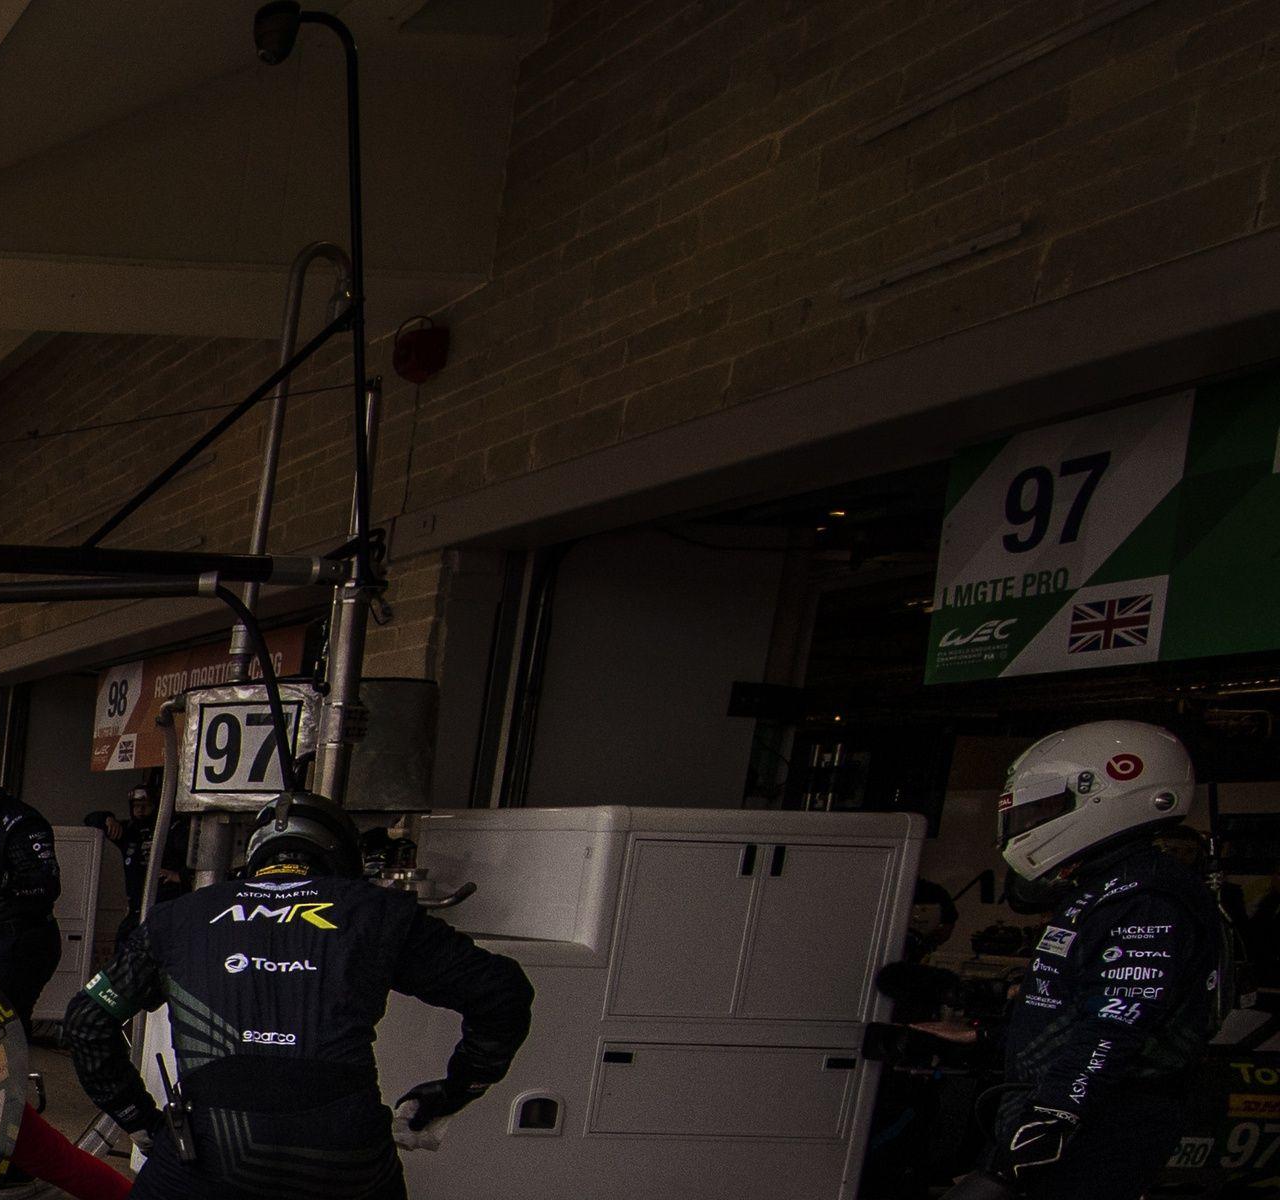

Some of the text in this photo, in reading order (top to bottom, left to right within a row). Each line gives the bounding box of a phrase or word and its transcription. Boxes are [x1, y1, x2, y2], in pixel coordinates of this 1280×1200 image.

[1002, 451, 1112, 554] 97
[1022, 567, 1070, 598] PRO
[939, 618, 1019, 648] WEC
[107, 679, 129, 718] 98
[204, 713, 291, 784] 97
[236, 889, 319, 899] ASTON MARTIN
[209, 902, 339, 930] AMR
[1111, 925, 1173, 937] HACKETT
[251, 957, 318, 972] TOTAL
[1126, 949, 1172, 958] TOTAL
[1108, 966, 1159, 981] DUPONT
[1104, 986, 1164, 999] uniper
[242, 1030, 296, 1046] sparco
[1087, 1039, 1114, 1073] ARTIN
[1220, 1121, 1280, 1169] 97
